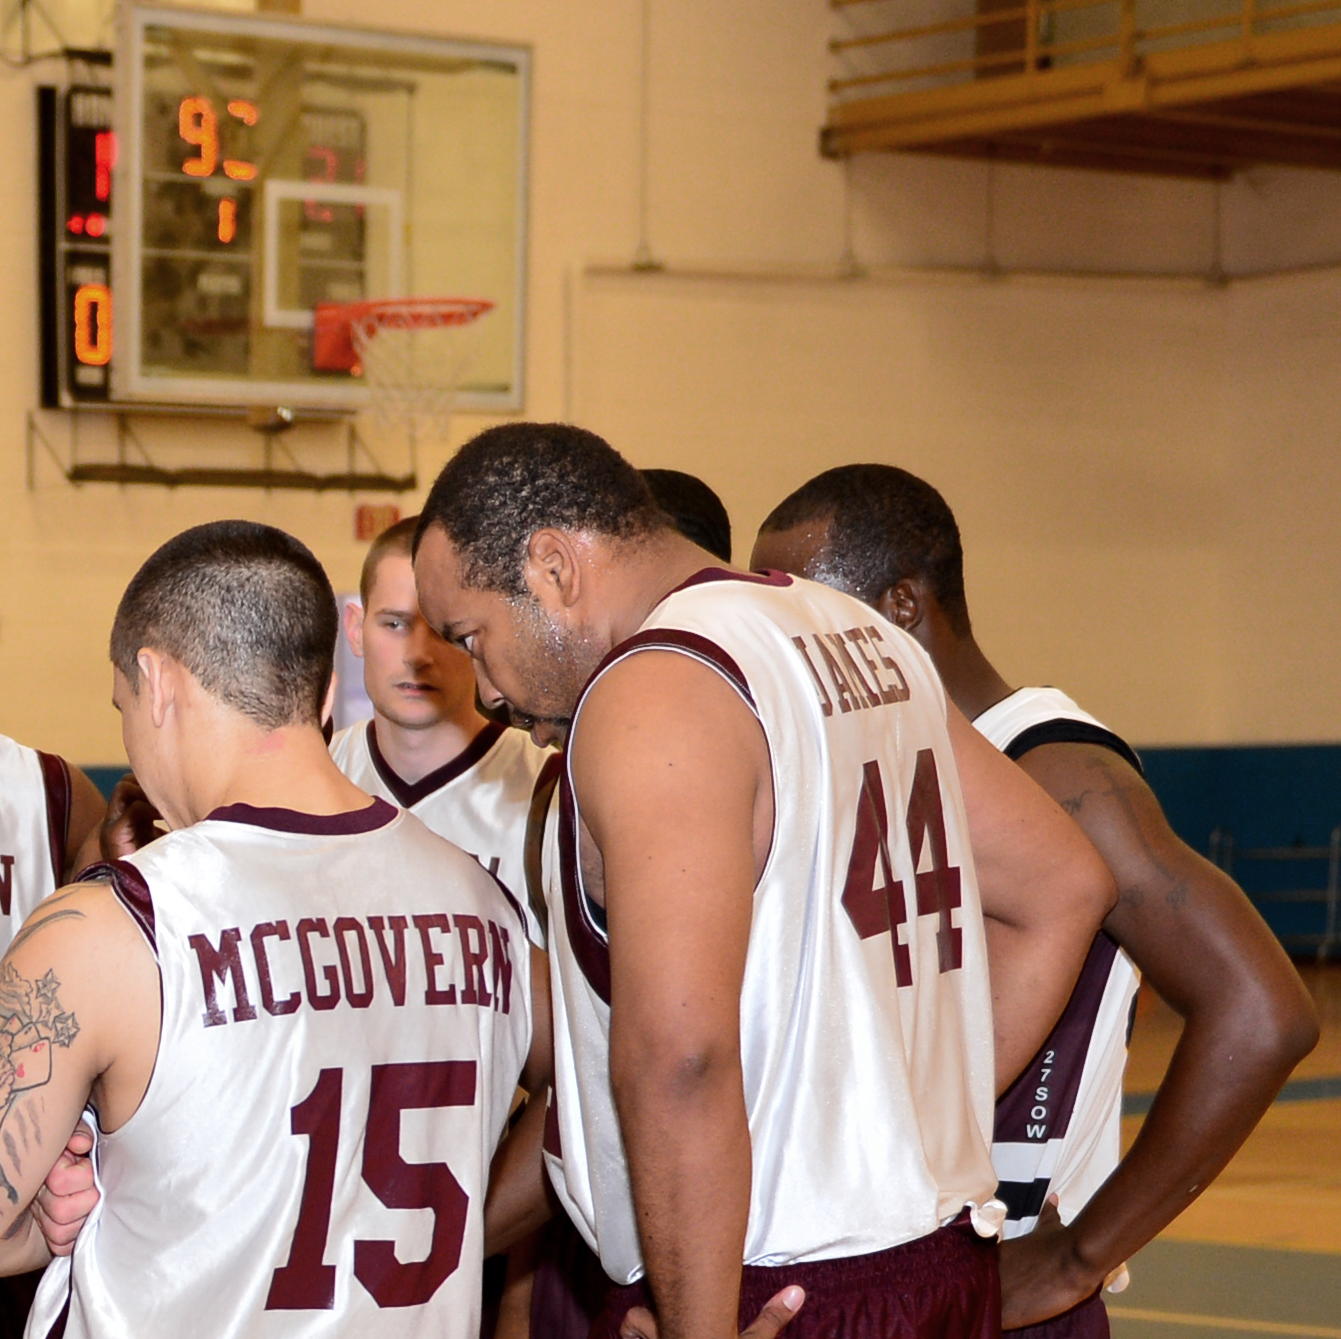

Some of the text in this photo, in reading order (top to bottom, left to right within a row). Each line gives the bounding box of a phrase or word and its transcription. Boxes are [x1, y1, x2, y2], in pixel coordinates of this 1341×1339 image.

[791, 626, 910, 717] JAMES
[841, 748, 963, 988] 44
[188, 913, 512, 1029] MCGOVERN
[264, 1060, 478, 1311] 15
